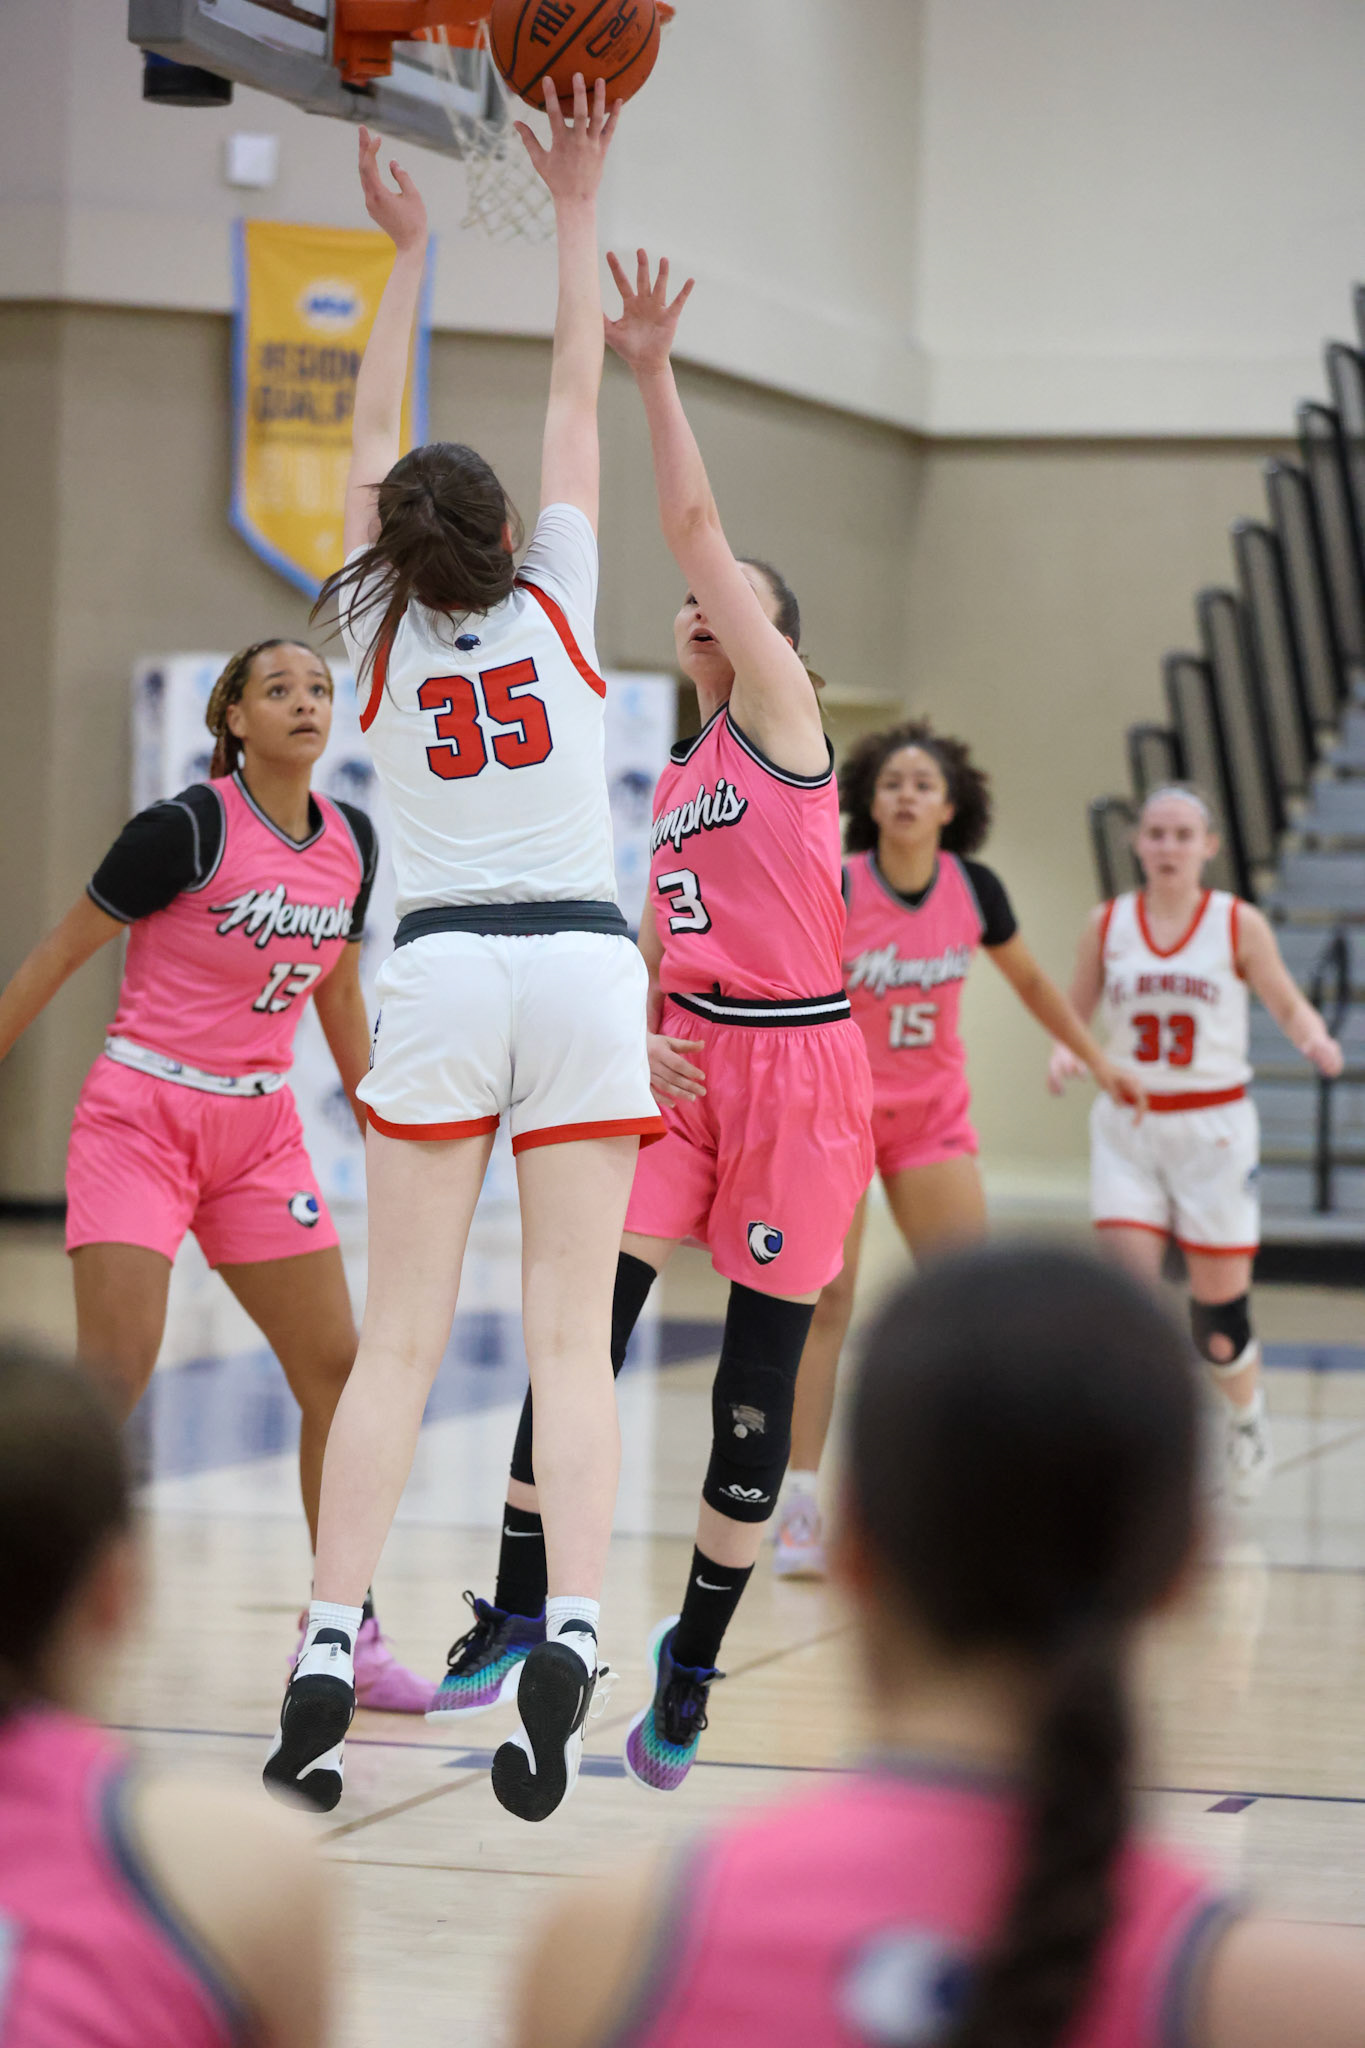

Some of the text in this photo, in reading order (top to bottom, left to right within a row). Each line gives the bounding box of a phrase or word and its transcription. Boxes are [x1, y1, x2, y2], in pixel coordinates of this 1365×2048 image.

[417, 657, 554, 781] 35
[208, 883, 353, 950] Memph
[656, 868, 713, 936] 3
[252, 963, 322, 1014] 13
[888, 1003, 939, 1049] 15
[1131, 1011, 1196, 1071] 33
